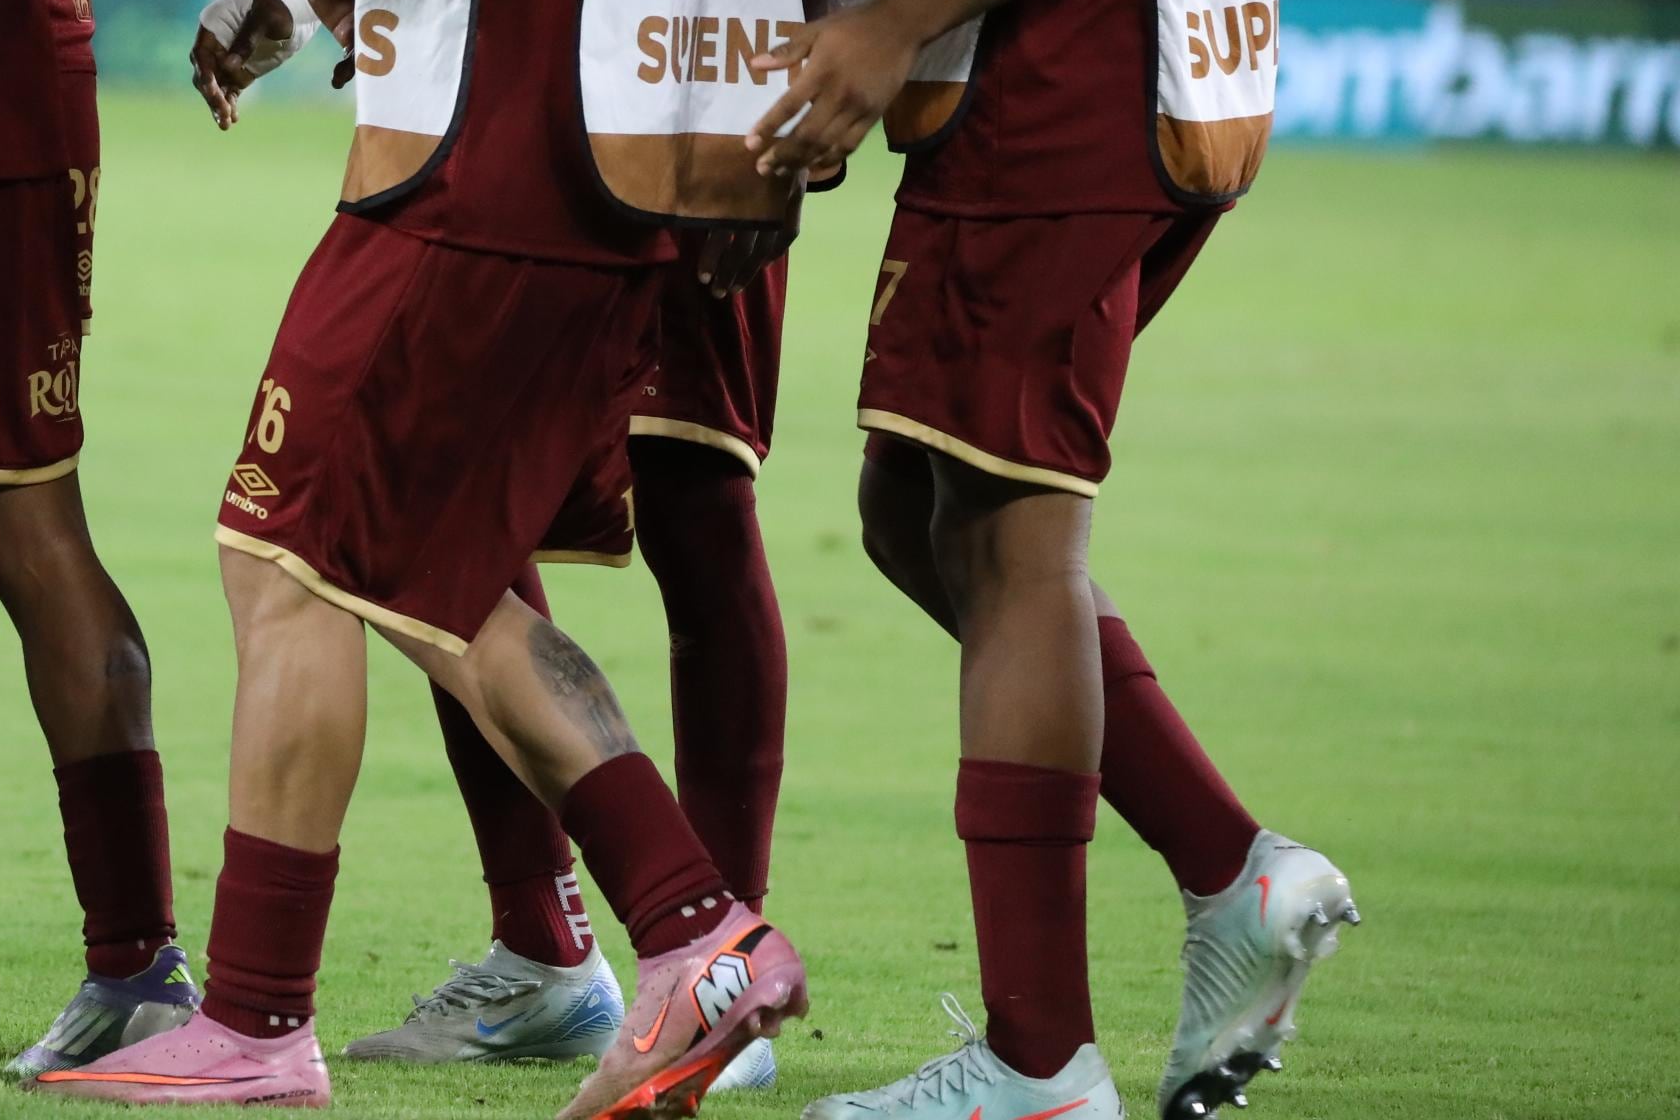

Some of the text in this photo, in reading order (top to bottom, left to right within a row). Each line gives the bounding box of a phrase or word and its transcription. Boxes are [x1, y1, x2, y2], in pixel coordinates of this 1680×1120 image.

[48, 338, 79, 361] TAPA
[28, 361, 78, 417] ROJ
[225, 489, 268, 520] umbro
